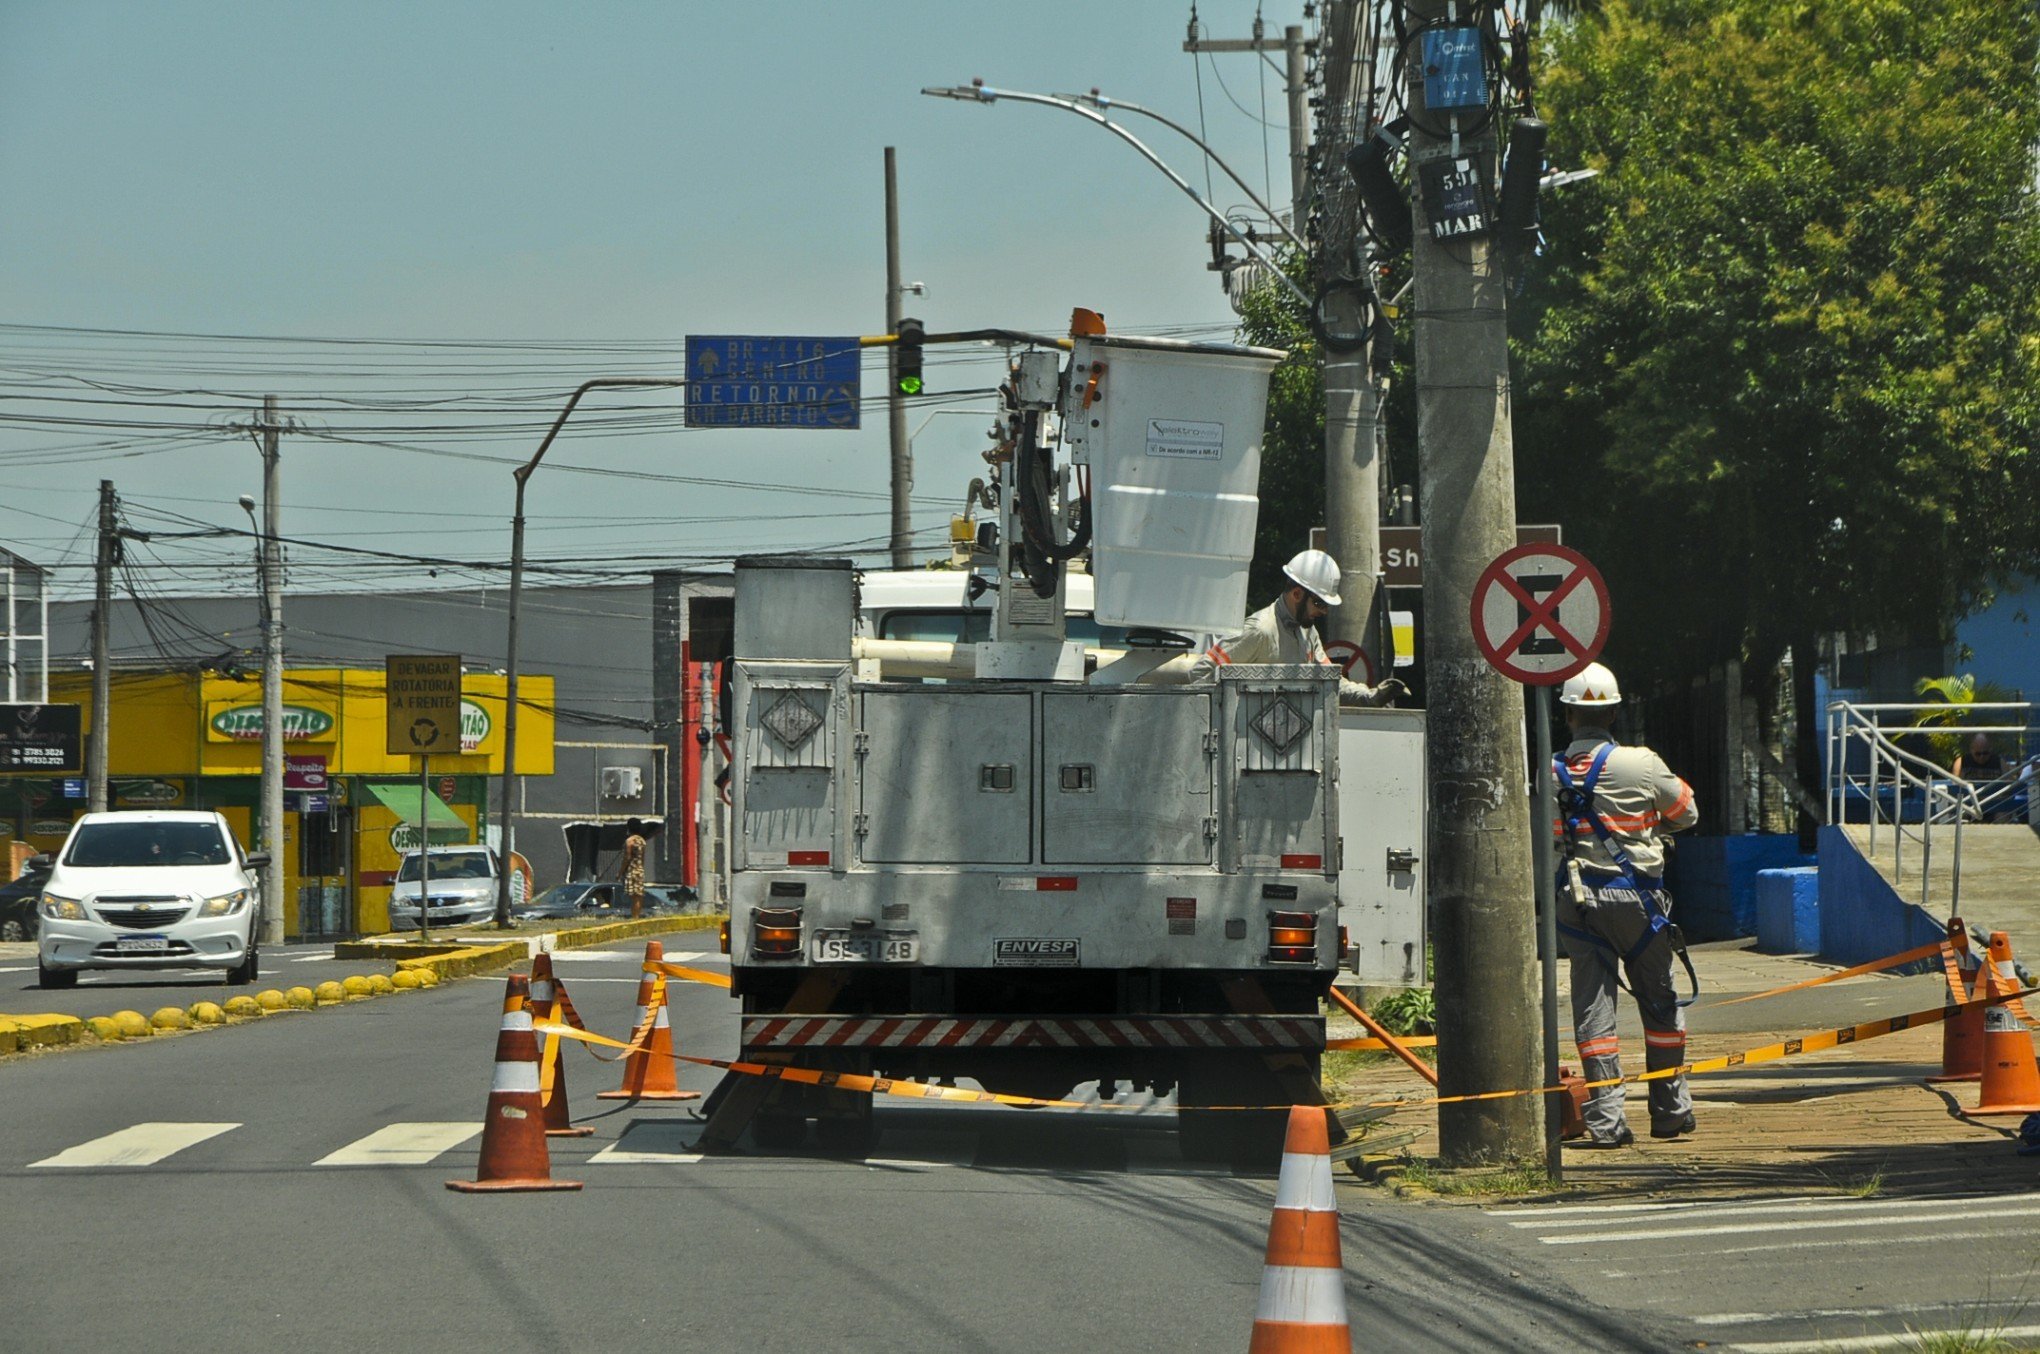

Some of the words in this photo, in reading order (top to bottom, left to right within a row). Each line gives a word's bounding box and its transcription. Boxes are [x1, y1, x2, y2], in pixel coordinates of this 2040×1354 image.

[691, 385, 817, 403] RETORNO
[398, 662, 450, 675] DEVAGAR
[408, 696, 453, 709] FRENTE
[1000, 941, 1074, 953] ENVESP
